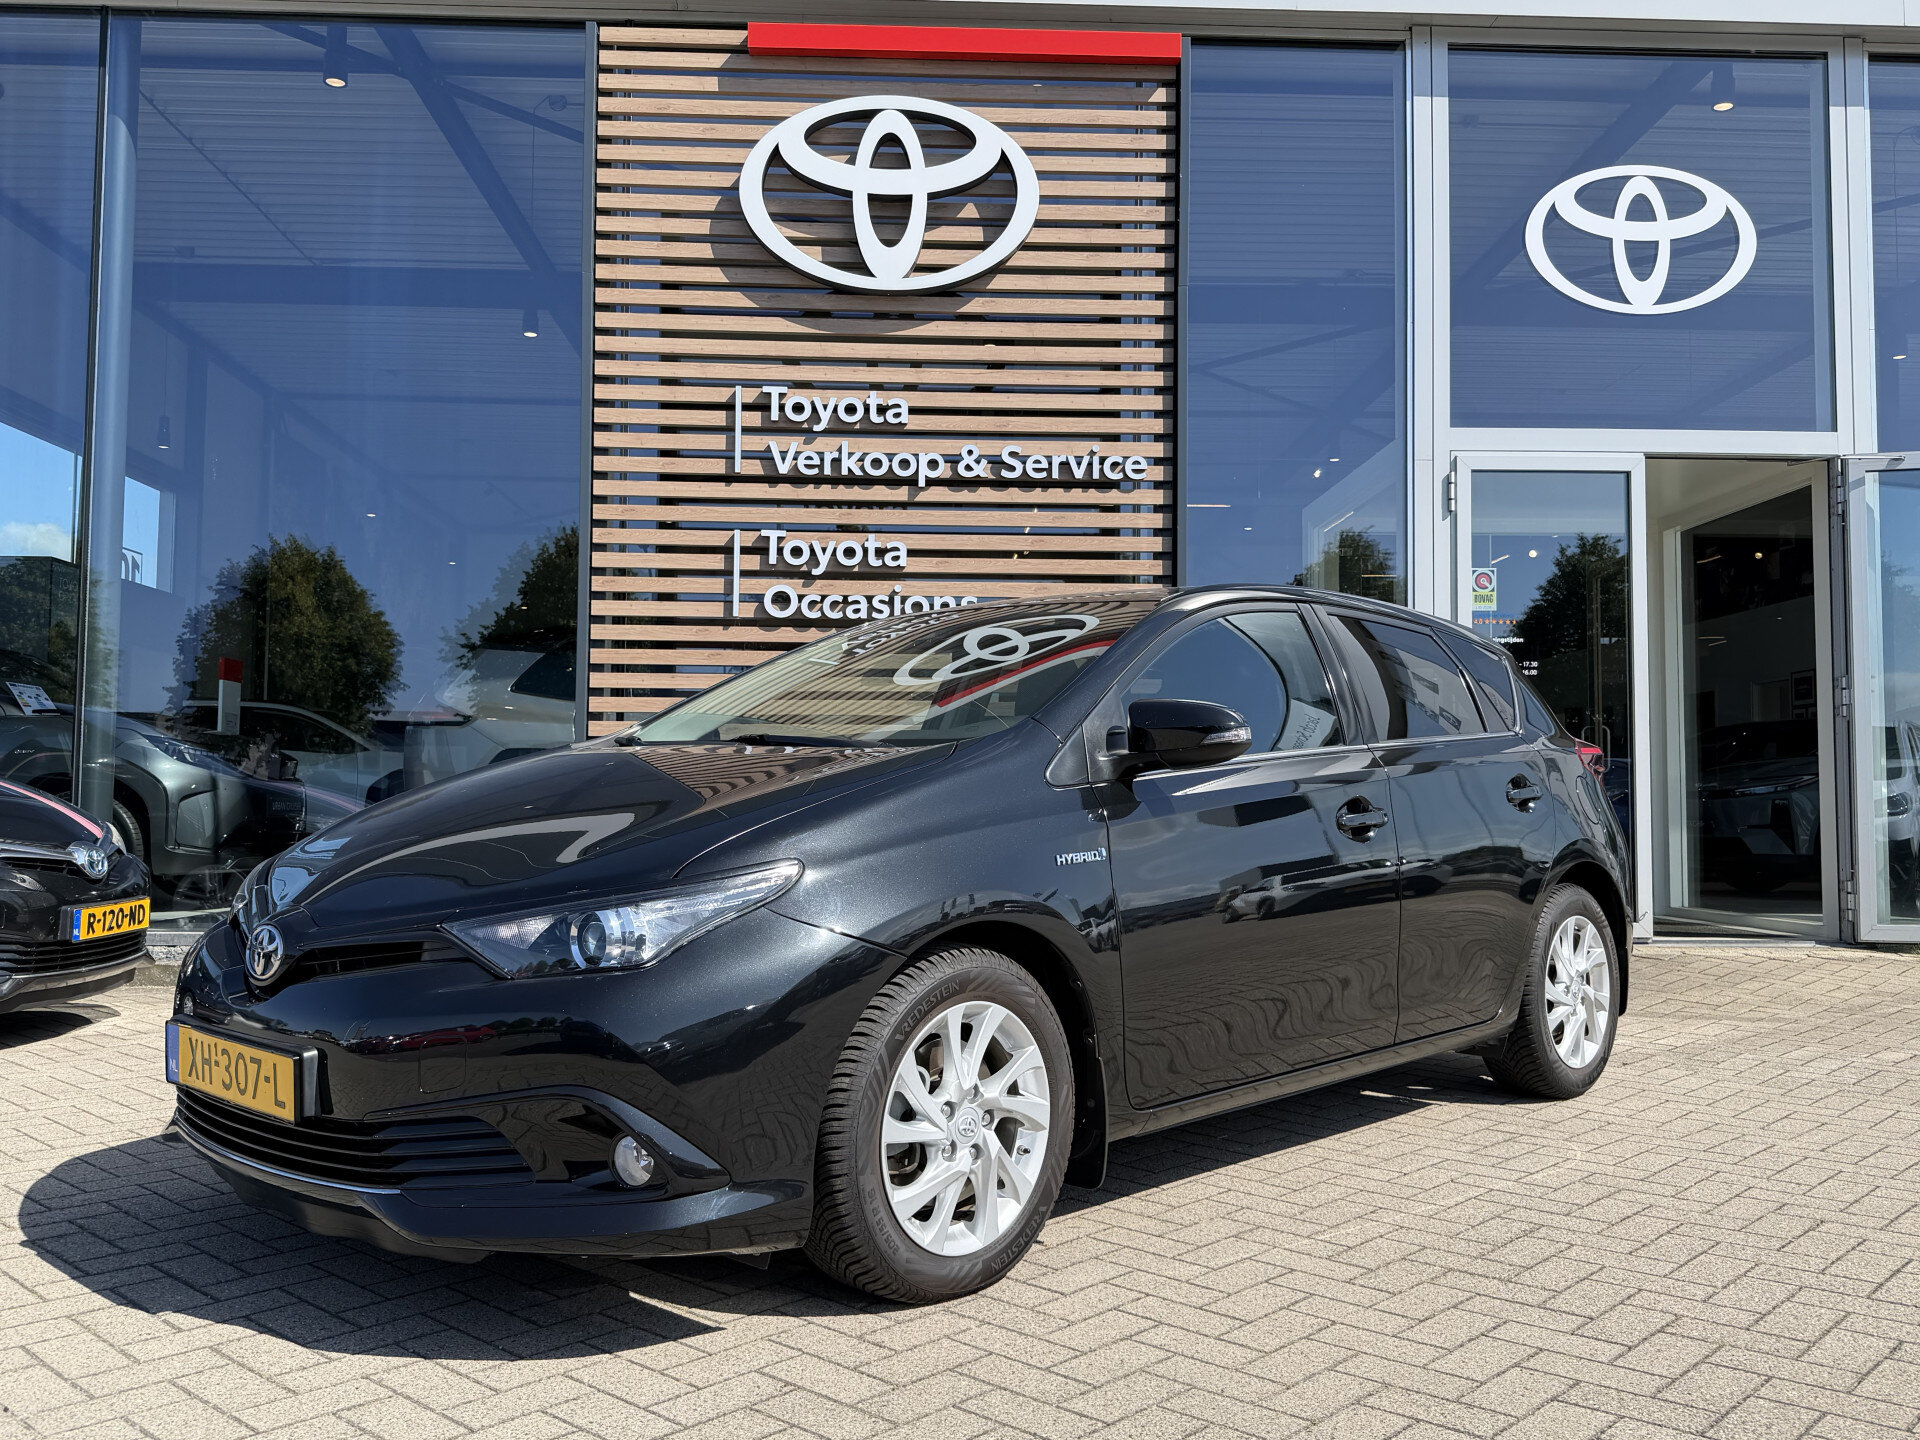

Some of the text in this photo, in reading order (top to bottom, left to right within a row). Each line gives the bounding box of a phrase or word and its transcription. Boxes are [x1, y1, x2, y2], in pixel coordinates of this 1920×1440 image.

[762, 386, 909, 432] Toyota
[769, 440, 1148, 487] Verkoop & Service
[761, 529, 907, 575] Toyota
[1474, 593, 1494, 604] BOVAG
[1056, 850, 1100, 866] HYBRID
[86, 904, 146, 936] R-120-ND
[894, 979, 961, 1042] VREDESTEIN
[187, 1037, 286, 1110] XH-307-L
